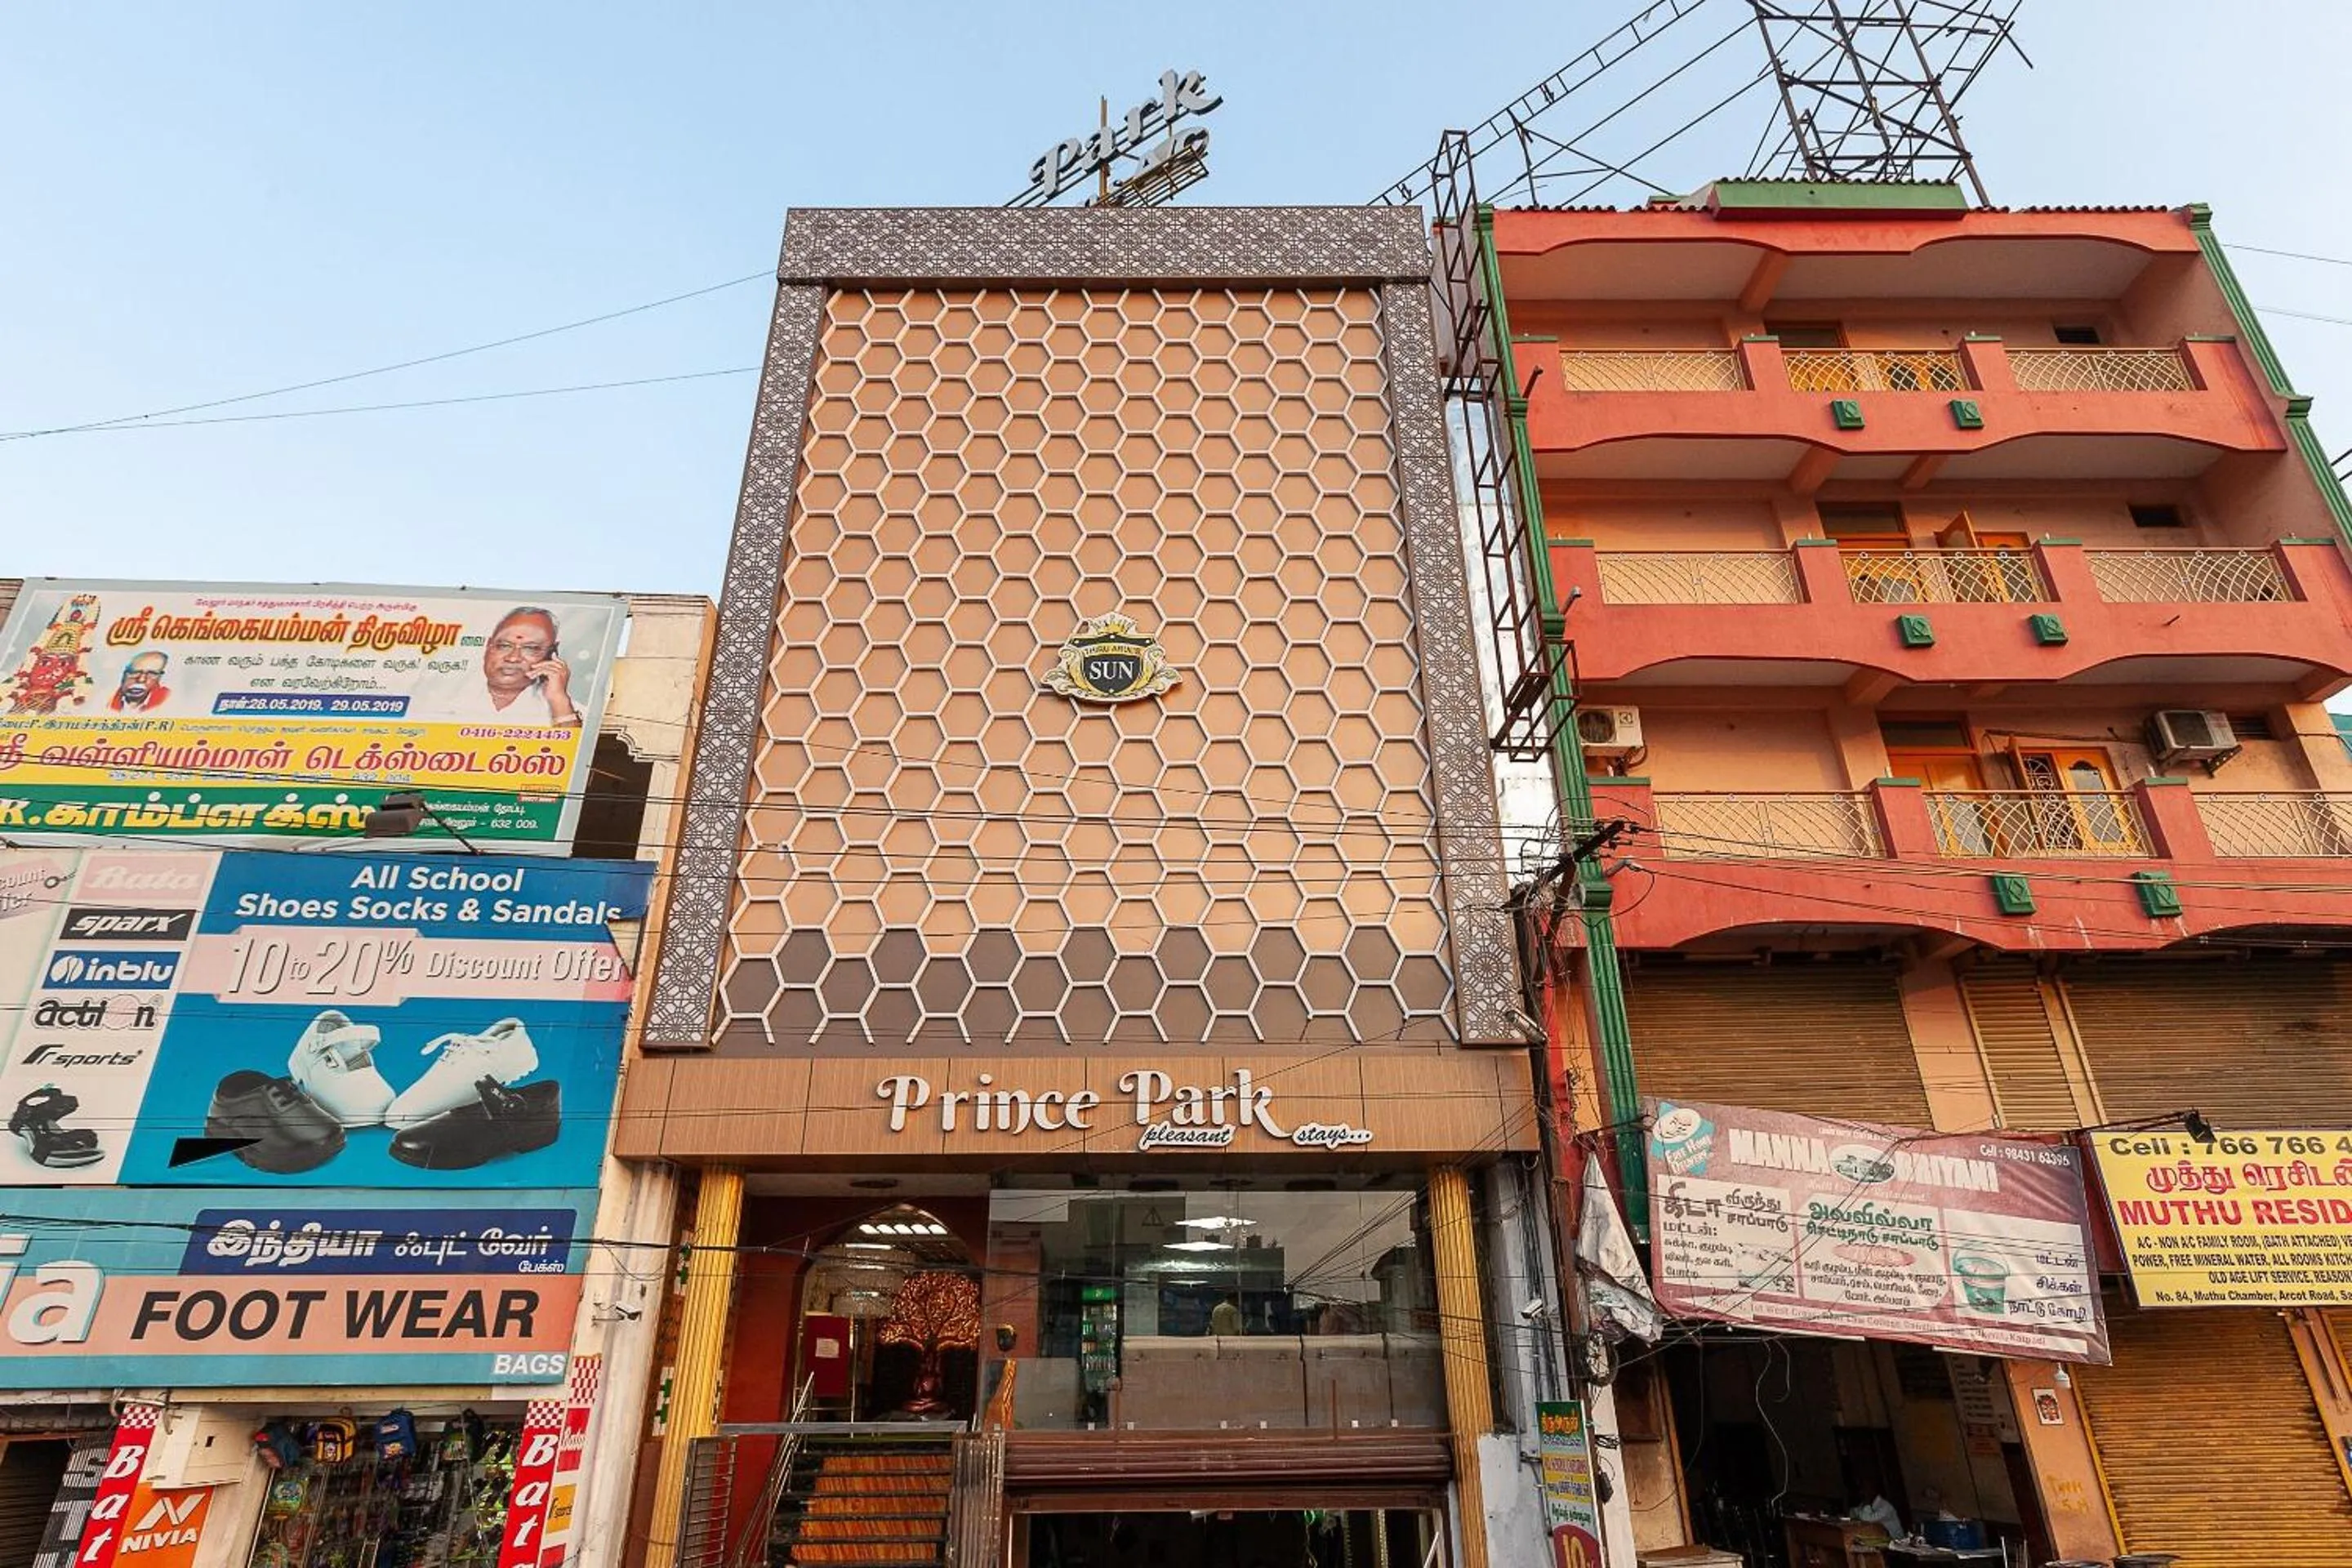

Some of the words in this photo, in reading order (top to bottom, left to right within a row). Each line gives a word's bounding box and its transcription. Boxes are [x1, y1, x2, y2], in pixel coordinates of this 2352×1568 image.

[1028, 68, 1223, 199] Park
[151, 611, 351, 643] கெங்கையம்மன்
[346, 614, 463, 653] திருவிழா
[227, 653, 264, 669] வரும்
[1089, 661, 1134, 680] SUN
[249, 677, 275, 688] என
[330, 698, 404, 715] 29.05.2019
[41, 737, 294, 771] வள்ளியம்மாள்
[305, 742, 566, 775] டெக்ஸ்டைல்ஸ்
[490, 819, 513, 829] 632
[86, 864, 201, 890] Bata
[350, 865, 400, 889] All
[407, 866, 524, 892] School
[234, 893, 340, 919] Shoes
[347, 895, 448, 921] Socks
[457, 898, 480, 922] &
[491, 899, 621, 924] Sandals
[70, 913, 187, 938] sparx
[85, 957, 174, 982] inblu
[228, 936, 291, 996] 10
[289, 957, 312, 981] to
[425, 949, 542, 979] Discount
[553, 946, 627, 982] Offer
[876, 1072, 1100, 1134] Prince
[1119, 1069, 1293, 1138] Park
[1143, 1124, 1231, 1145] pleasant
[2110, 1138, 2171, 1155] Cell
[2266, 1137, 2325, 1155] 766
[1728, 1129, 1832, 1175] MANNA
[2005, 1147, 2035, 1162] 98431
[2146, 1160, 2236, 1195] முத்து
[1726, 1188, 1781, 1212] விருந்து
[1727, 1212, 1788, 1233] சாப்பாடு
[2118, 1200, 2243, 1226] MUTHU
[2252, 1199, 2352, 1226] RESID
[206, 1219, 384, 1267] இந்தியா
[394, 1232, 469, 1266] ஃபுட்
[478, 1225, 553, 1256] வேர்
[1882, 1232, 1940, 1250] சாப்பாடு
[2159, 1236, 2178, 1249] NON
[2198, 1235, 2227, 1248] FAMILY
[2036, 1251, 2078, 1267] மட்டன்
[2132, 1254, 2169, 1269] POWER,
[2170, 1254, 2193, 1266] FREE
[2194, 1254, 2234, 1266] MINERAL
[2273, 1254, 2290, 1266] ALL
[2292, 1254, 2323, 1266] ROOMS
[2036, 1275, 2082, 1294] சிக்கன்
[2208, 1272, 2227, 1284] OLD
[2230, 1272, 2248, 1284] AGE
[2251, 1272, 2268, 1283] LIFT
[2156, 1291, 2174, 1301] No.
[2194, 1291, 2225, 1301] Muthu
[2279, 1290, 2306, 1300] Arcot
[130, 1290, 327, 1341] FOOT
[345, 1290, 540, 1340] WEAR
[2007, 1298, 2045, 1317] நாட்டு
[493, 1353, 567, 1376] BAGS
[121, 1527, 198, 1553] NIVIA
